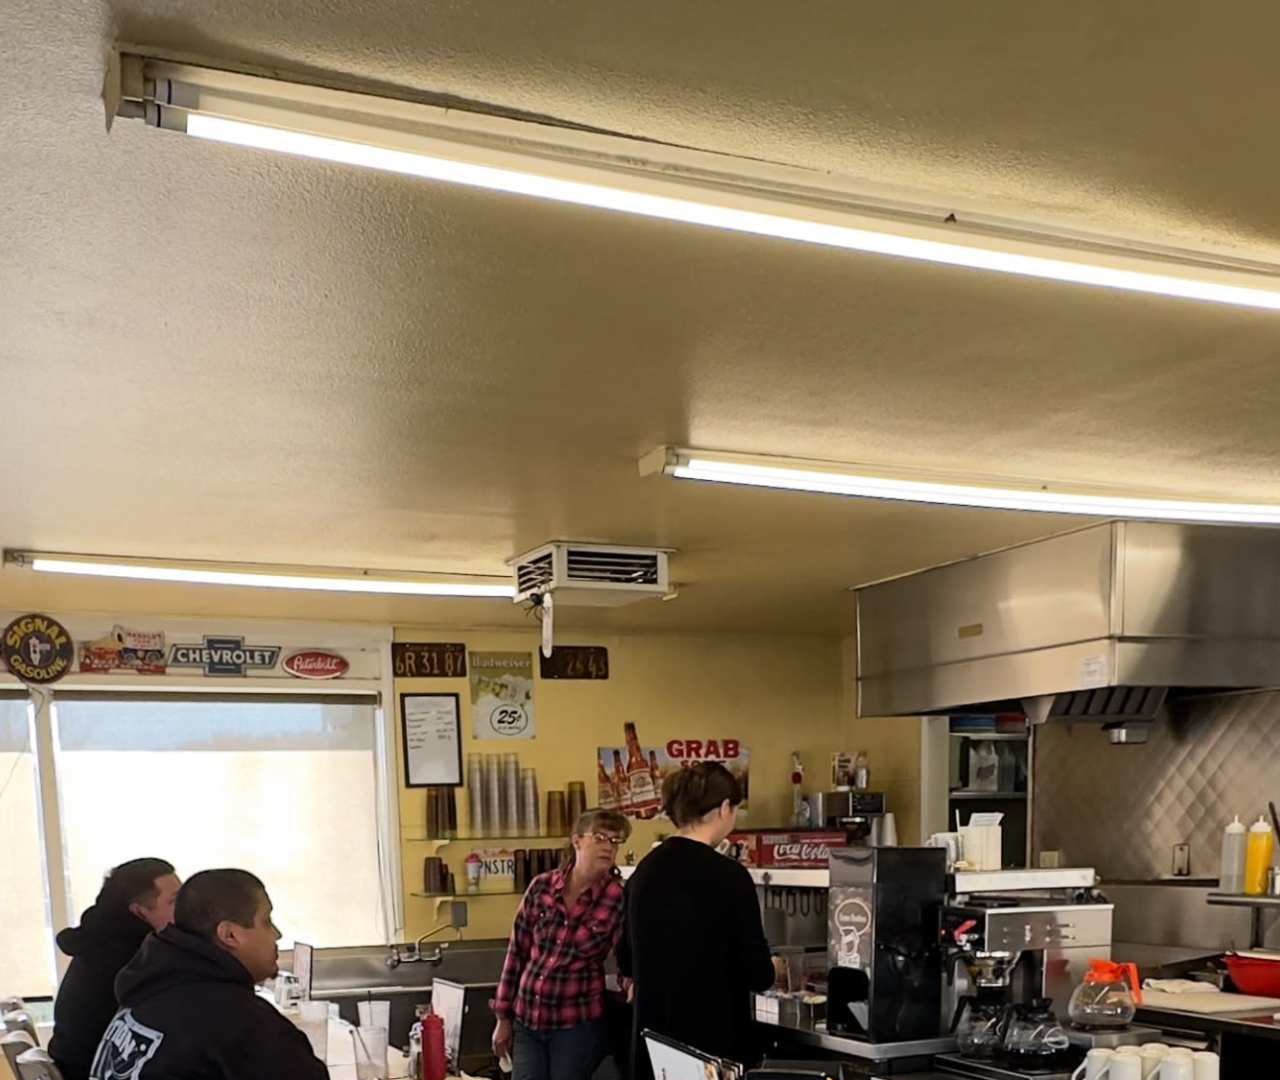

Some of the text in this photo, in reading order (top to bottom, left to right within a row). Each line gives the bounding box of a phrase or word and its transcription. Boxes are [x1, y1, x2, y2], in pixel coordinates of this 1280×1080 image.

[5, 617, 68, 650] SIGNAL
[176, 649, 272, 665] CHEVROLET
[293, 655, 340, 671] Peterbilt
[472, 655, 531, 668] Budweiser
[10, 653, 69, 681] GASOLINE
[665, 739, 740, 759] GRAB
